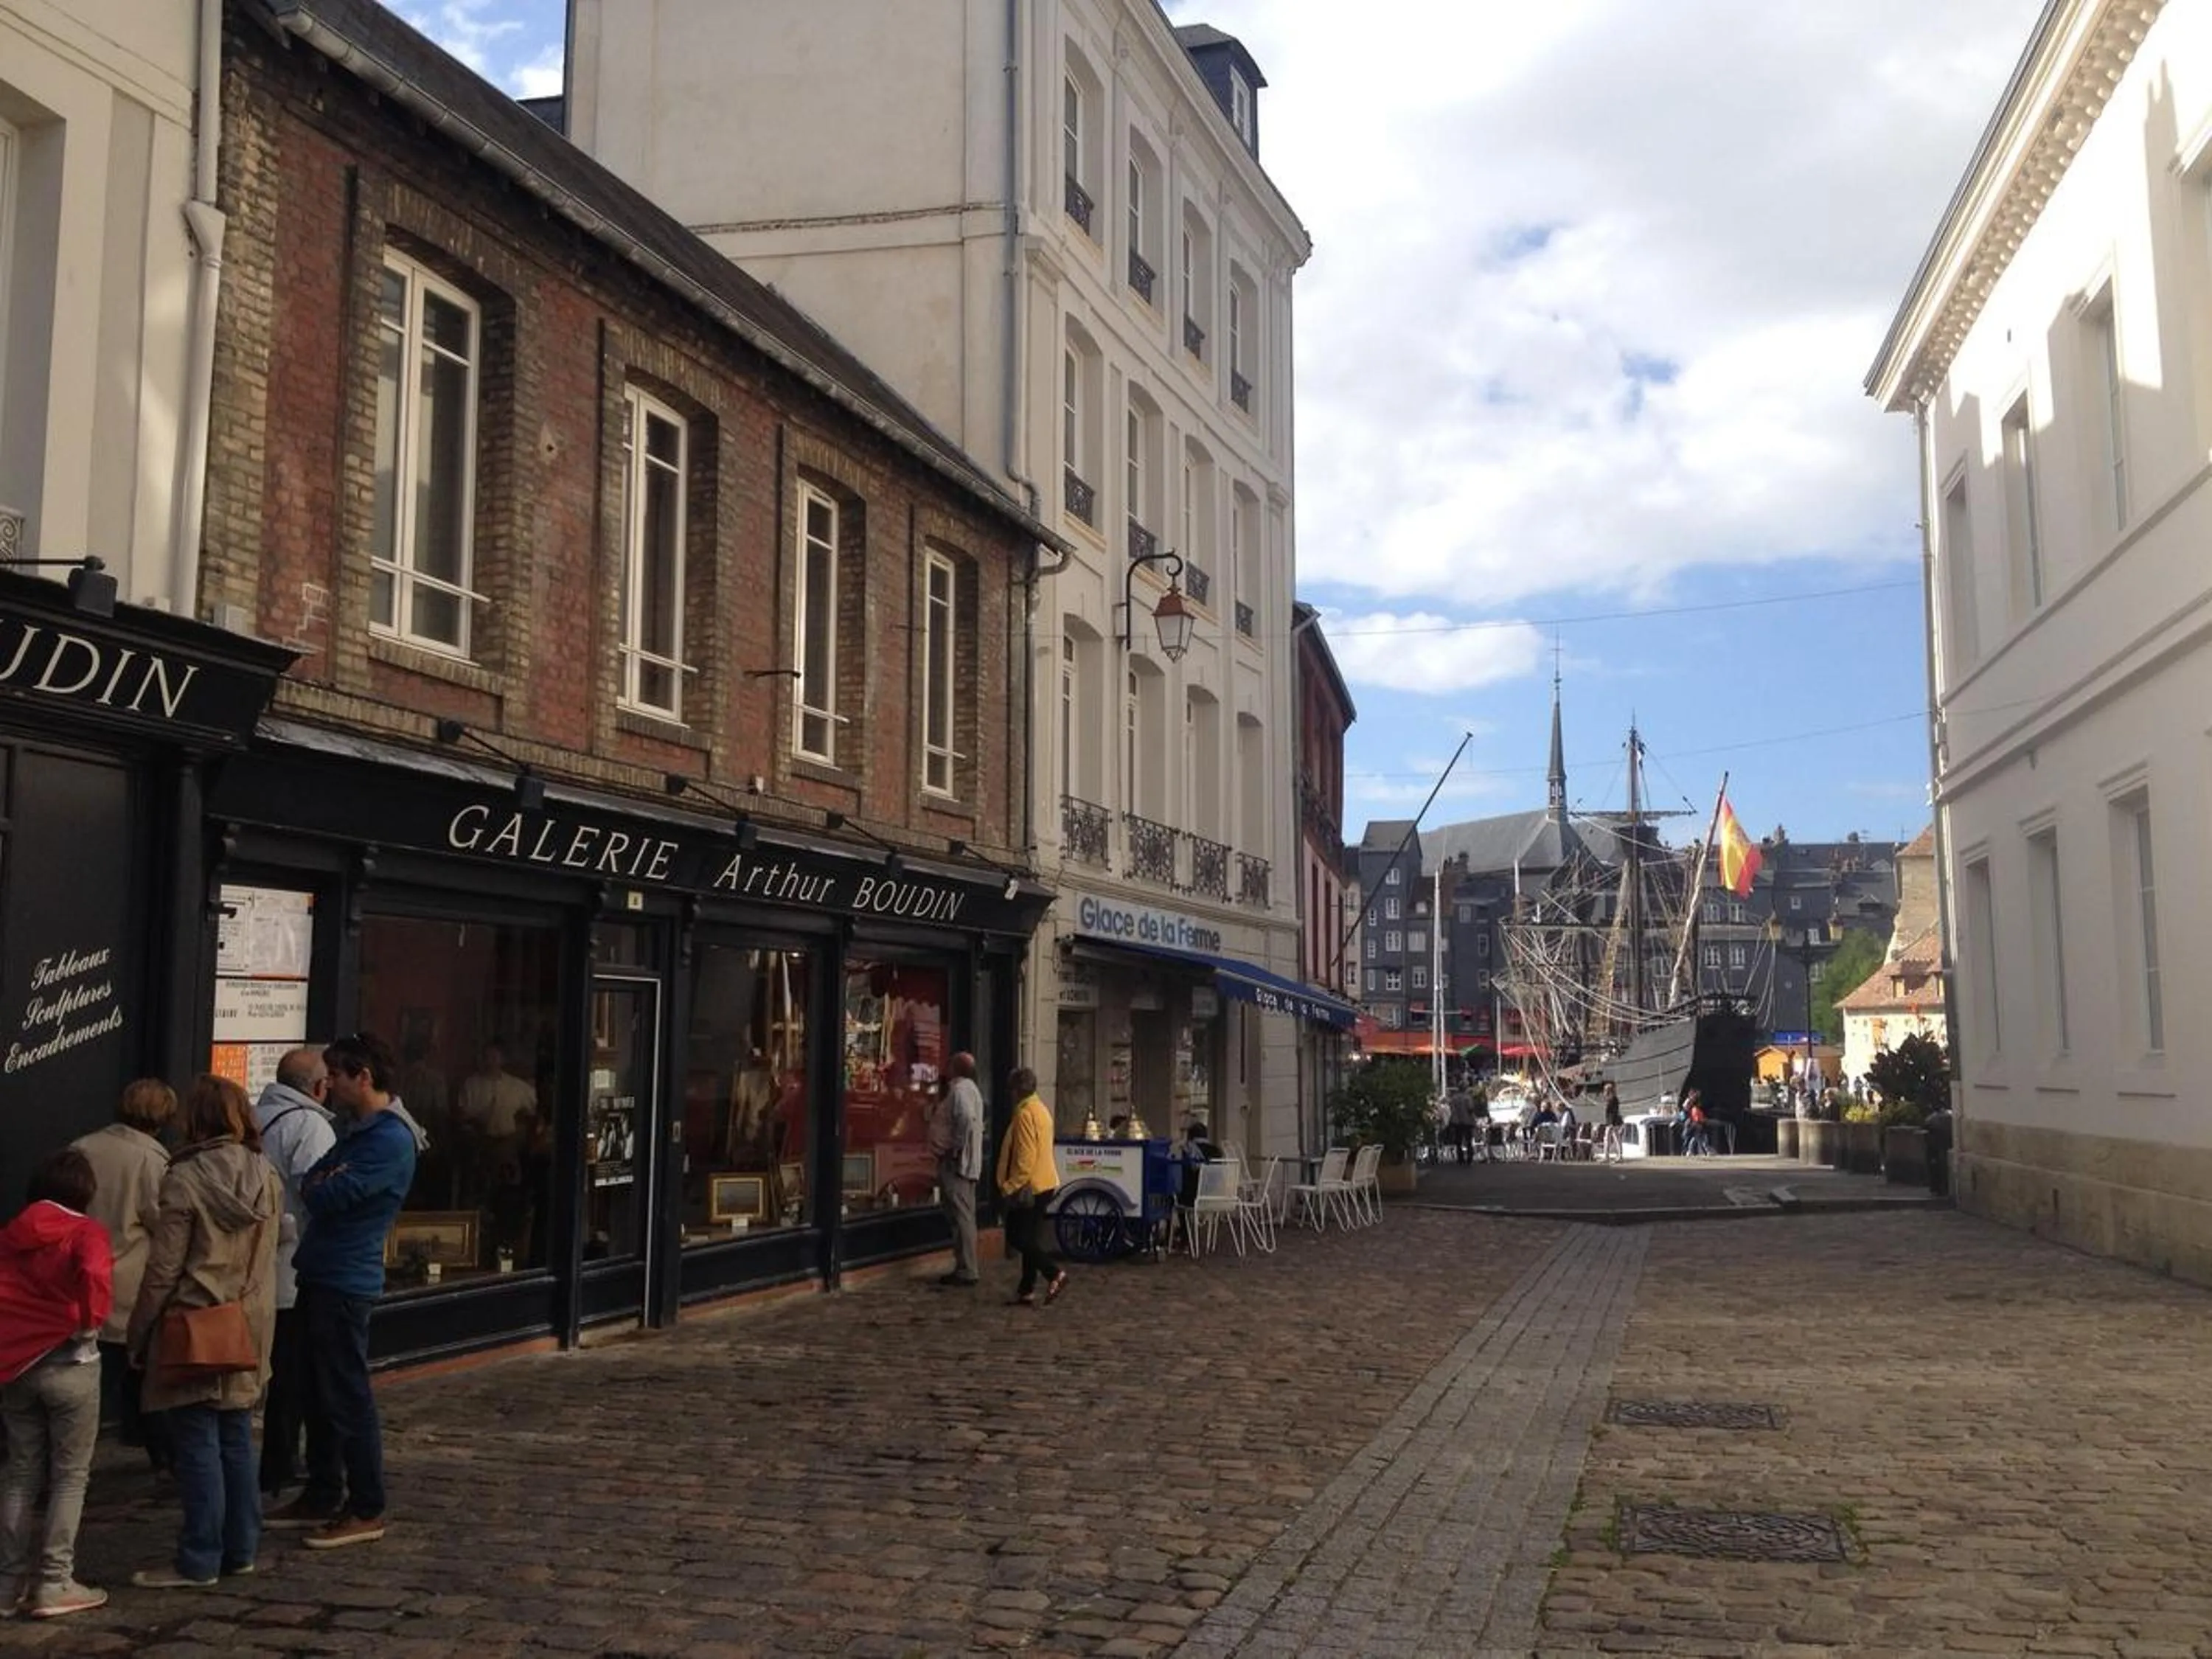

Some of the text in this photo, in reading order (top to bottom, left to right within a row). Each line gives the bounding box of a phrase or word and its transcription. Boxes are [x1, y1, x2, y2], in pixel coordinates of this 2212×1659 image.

[448, 804, 964, 922] GALERIE Arthur BOUDIN
[1138, 911, 1158, 941] de
[1161, 915, 1175, 945] la
[1179, 917, 1220, 953] Ferme
[31, 947, 110, 990] Tableaux
[21, 979, 112, 1031] Sculptures
[4, 1004, 122, 1074] Encadrements
